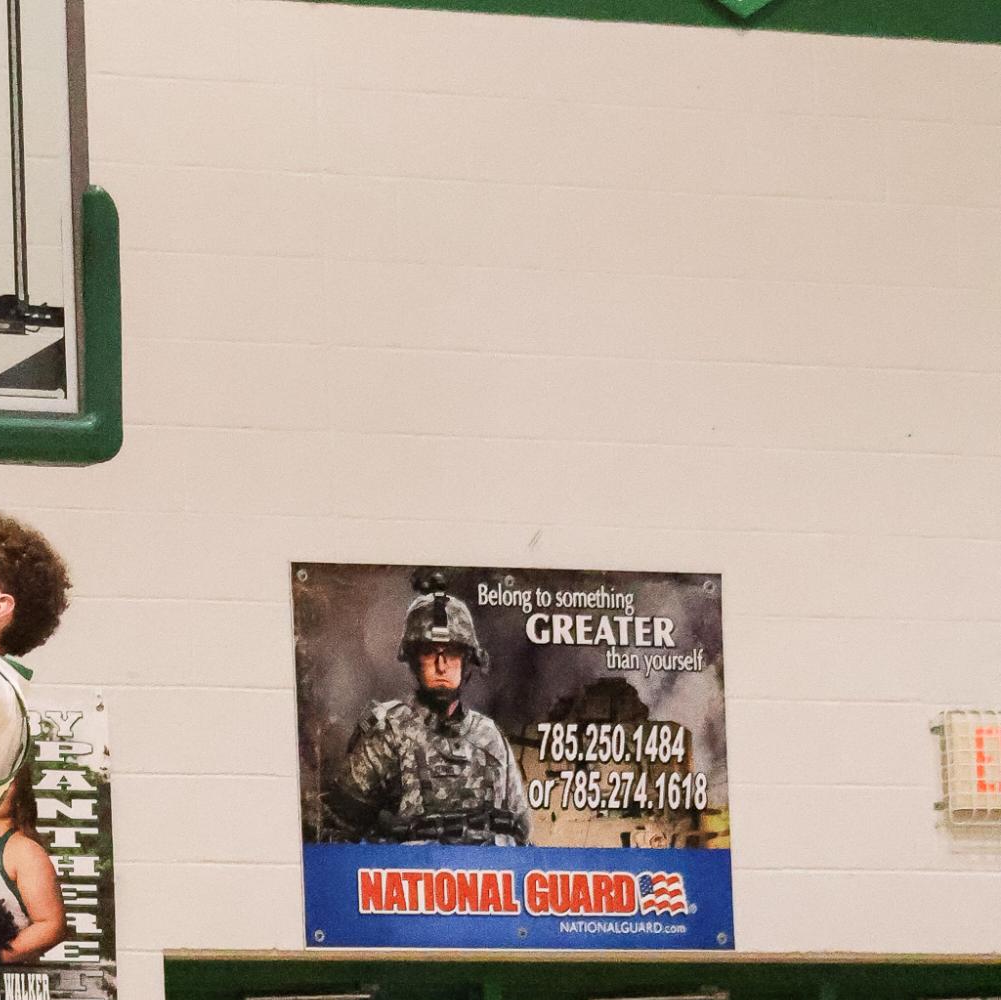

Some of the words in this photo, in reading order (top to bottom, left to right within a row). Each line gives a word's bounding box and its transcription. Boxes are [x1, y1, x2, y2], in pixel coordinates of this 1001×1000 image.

[478, 583, 532, 613] Belong
[536, 588, 551, 607] to
[555, 586, 634, 615] something
[525, 613, 676, 647] GREATER
[606, 647, 639, 670] than
[644, 649, 703, 677] yourself
[537, 723, 686, 764] 785.250.1484
[528, 779, 555, 809] or
[560, 771, 708, 810] 785.274.1618
[357, 869, 520, 915] NATIONAL
[524, 870, 640, 916] GUARD
[559, 920, 687, 935] NATIONALGUARD.com
[3, 973, 50, 1000] WALKER
